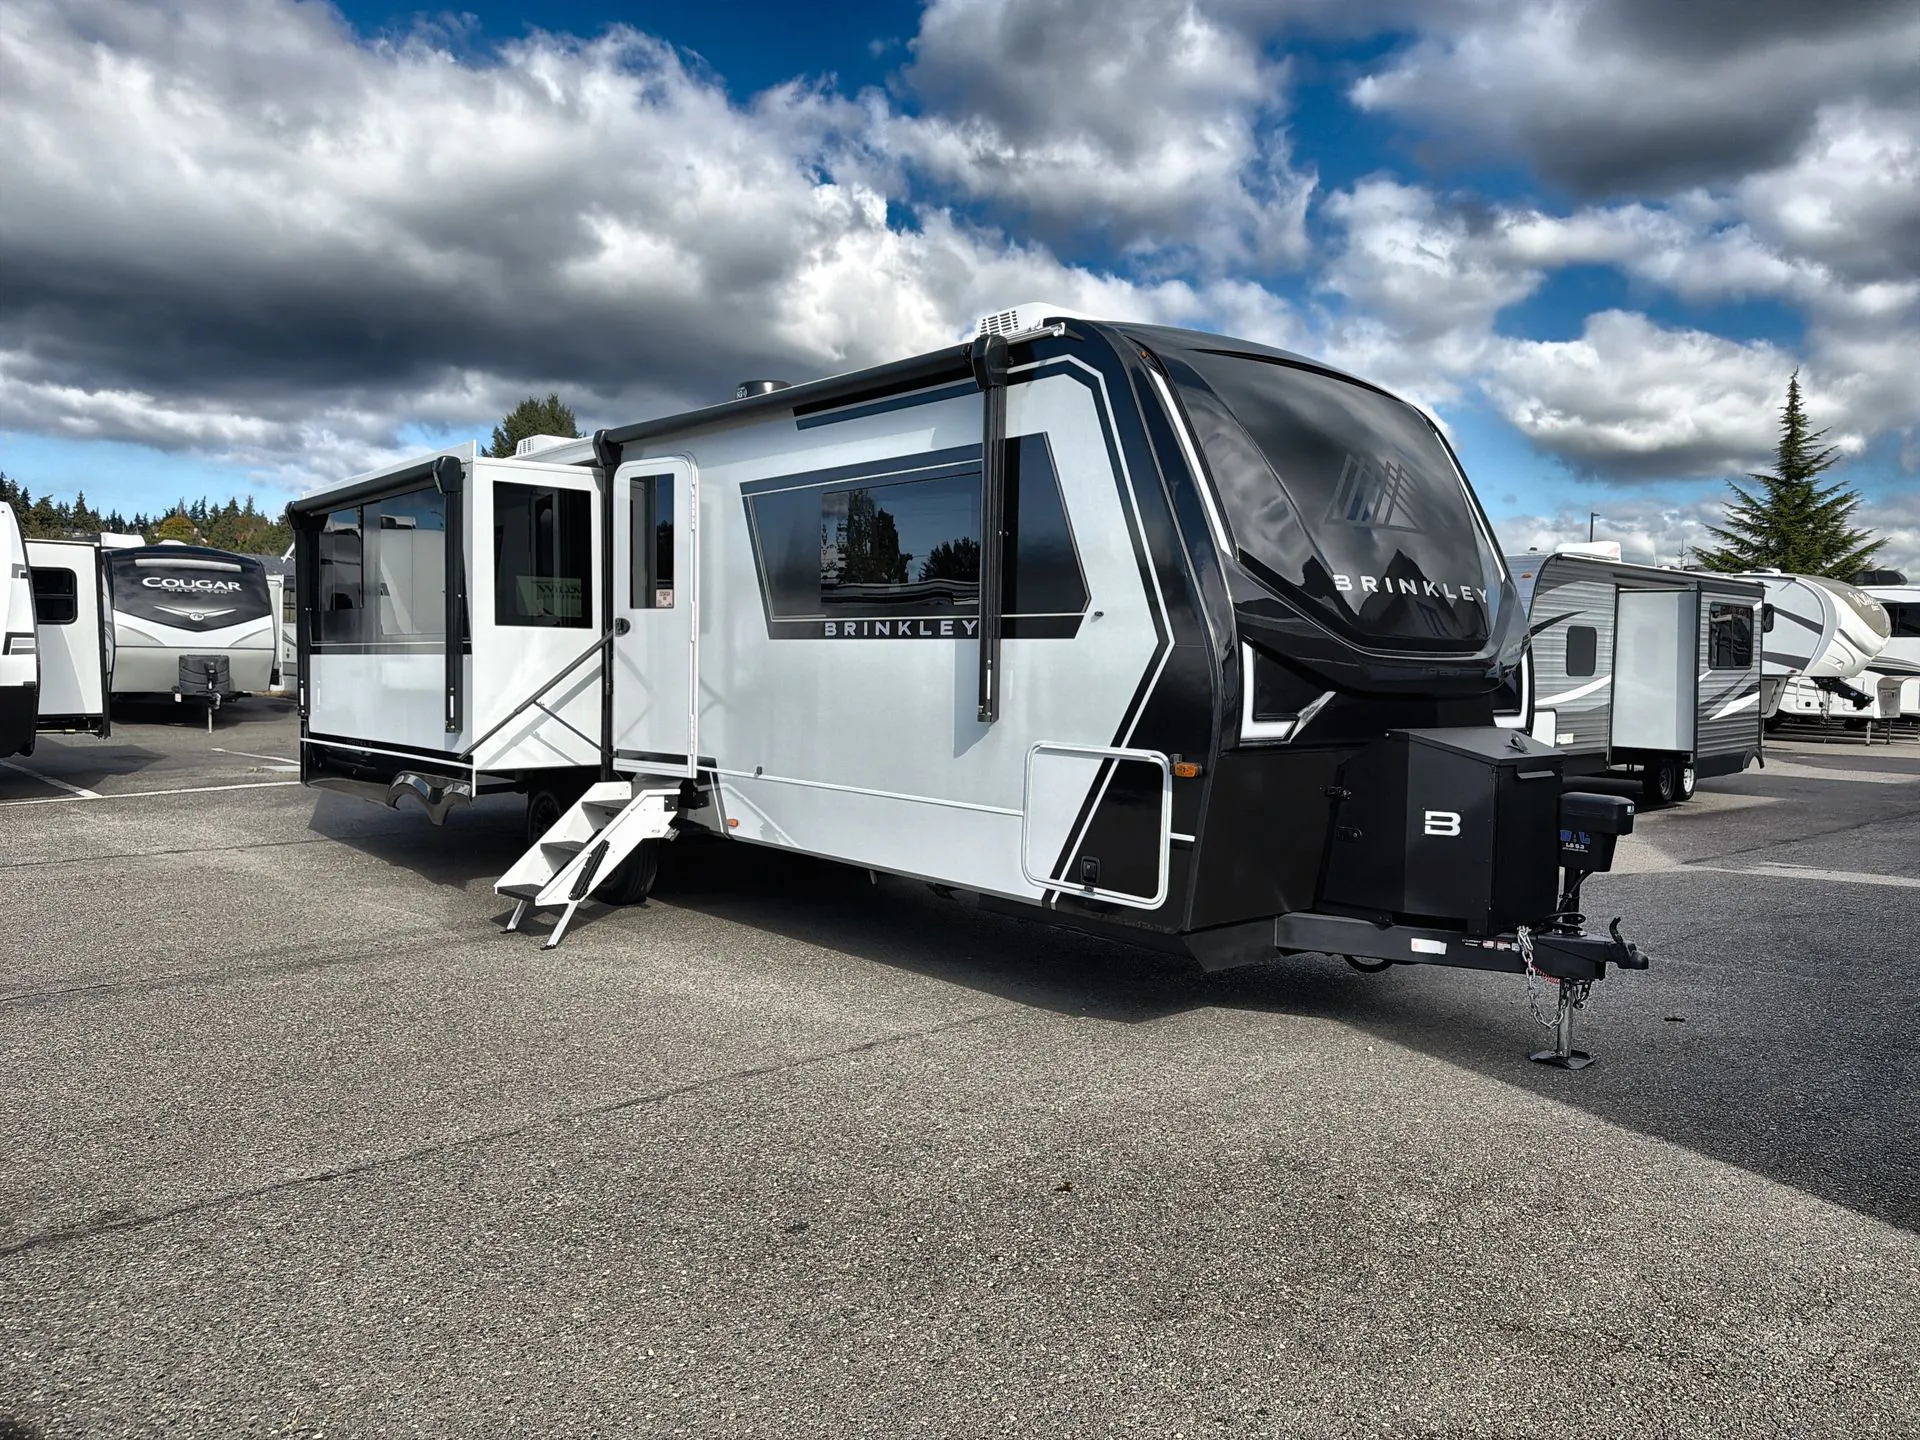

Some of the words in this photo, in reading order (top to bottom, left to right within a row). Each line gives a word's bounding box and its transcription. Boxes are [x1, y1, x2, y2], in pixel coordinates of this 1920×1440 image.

[142, 577, 242, 592] COUGAR
[1333, 574, 1487, 603] BRINKLEY
[825, 620, 978, 636] BRINKLEY
[1425, 811, 1461, 836] B
